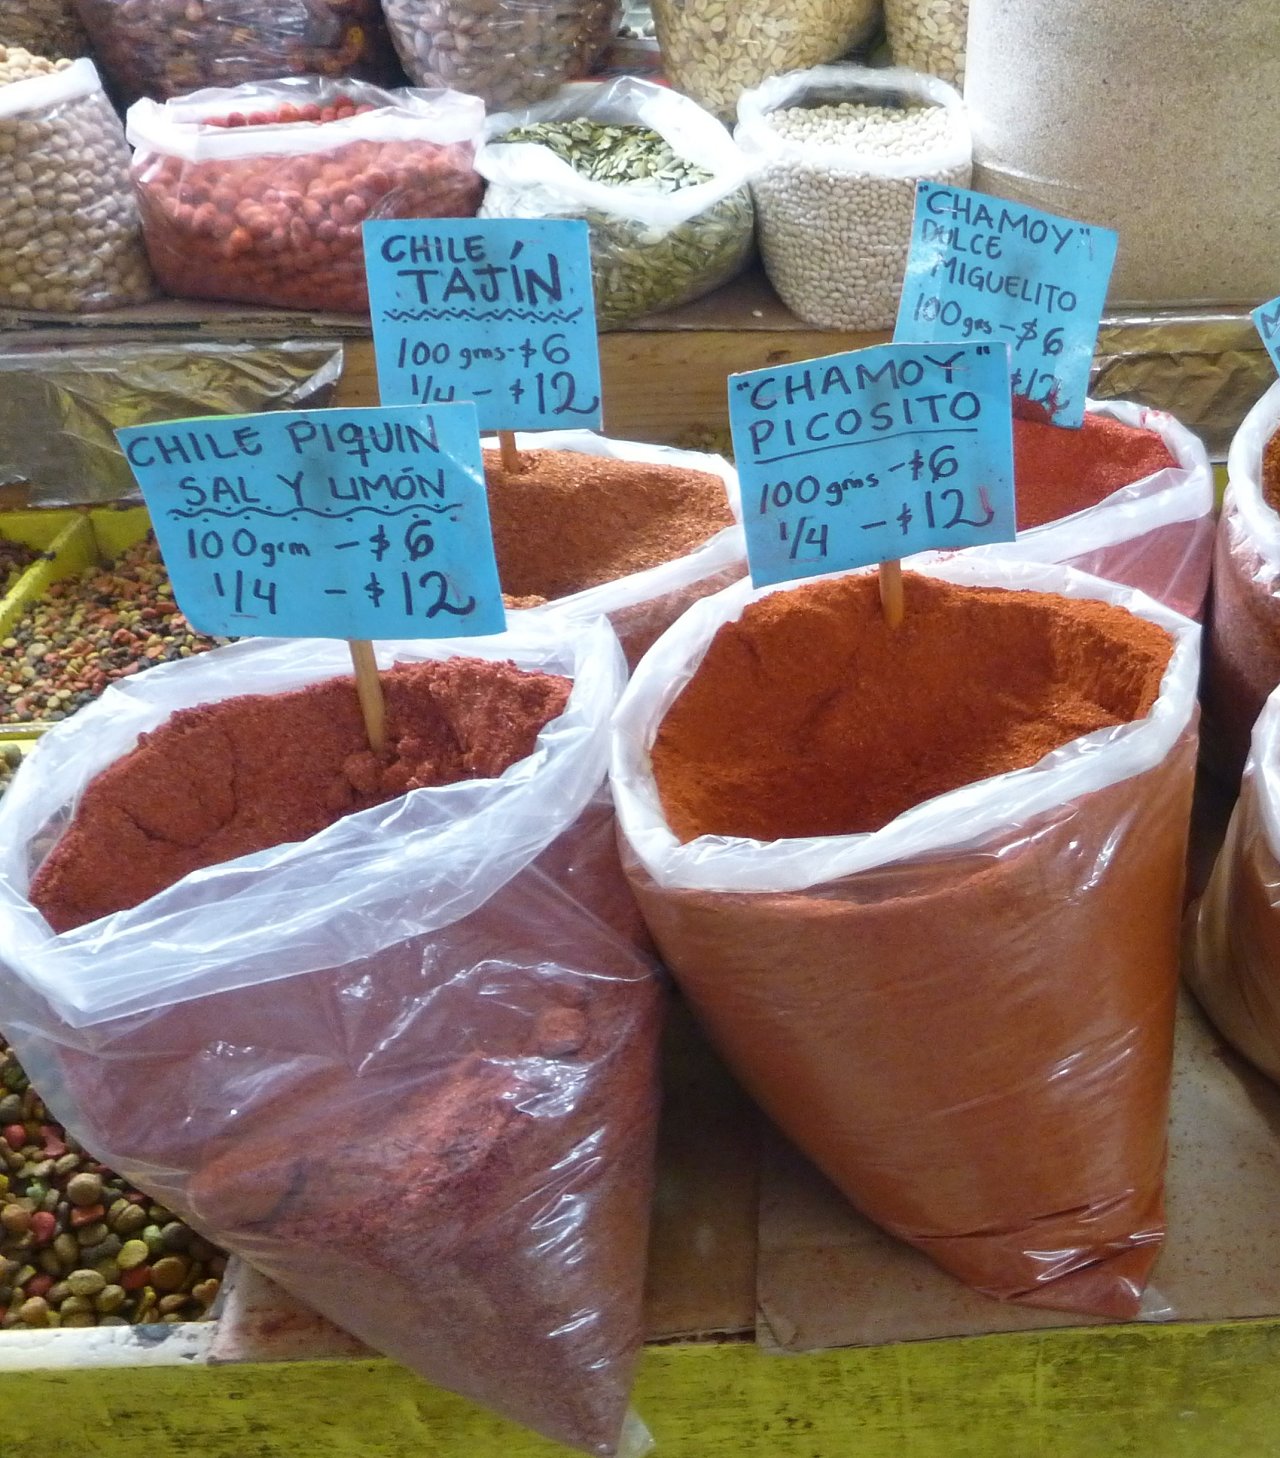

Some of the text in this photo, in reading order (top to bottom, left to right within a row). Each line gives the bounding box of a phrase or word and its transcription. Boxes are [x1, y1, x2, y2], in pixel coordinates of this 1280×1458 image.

[381, 235, 486, 263] CHILE
[922, 218, 1001, 259] DULCE
[397, 240, 562, 305] TAJÍN
[931, 253, 1077, 314] MIGUELITO
[737, 346, 990, 410] "CHAMOY"
[748, 391, 981, 455] PICOSITO
[126, 426, 262, 467] CHILE
[179, 467, 445, 507] SAL Y LIMÓN
[779, 516, 827, 559] 1/4
[214, 570, 276, 614] 1/4
